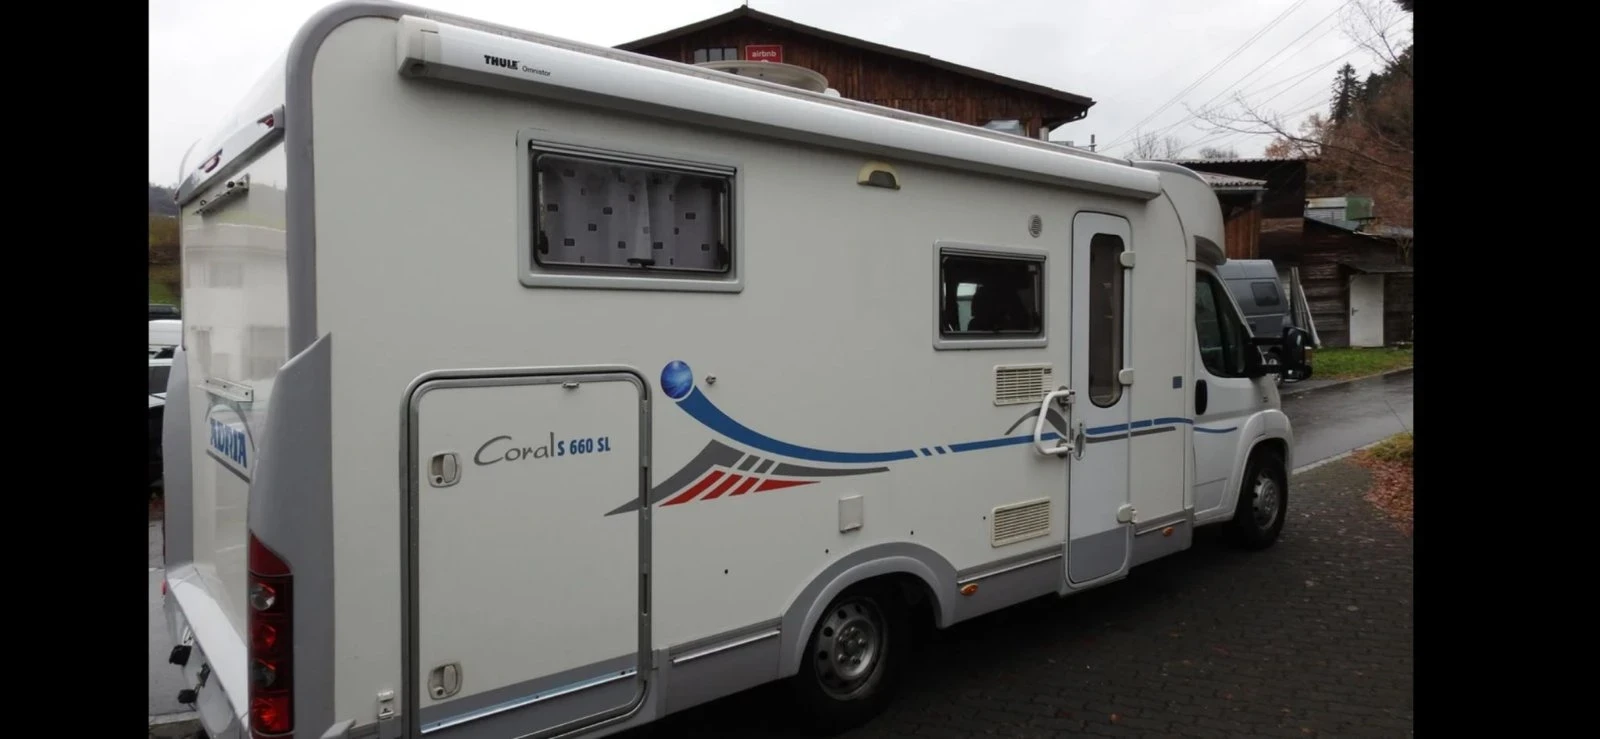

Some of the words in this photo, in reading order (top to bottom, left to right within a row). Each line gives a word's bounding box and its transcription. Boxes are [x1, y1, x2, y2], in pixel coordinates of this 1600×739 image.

[484, 54, 519, 70] THULE
[752, 50, 777, 58] airbnb
[210, 417, 247, 469] ADRIA
[473, 431, 555, 466] Coral
[569, 438, 594, 455] 660
[597, 436, 611, 452] SL
